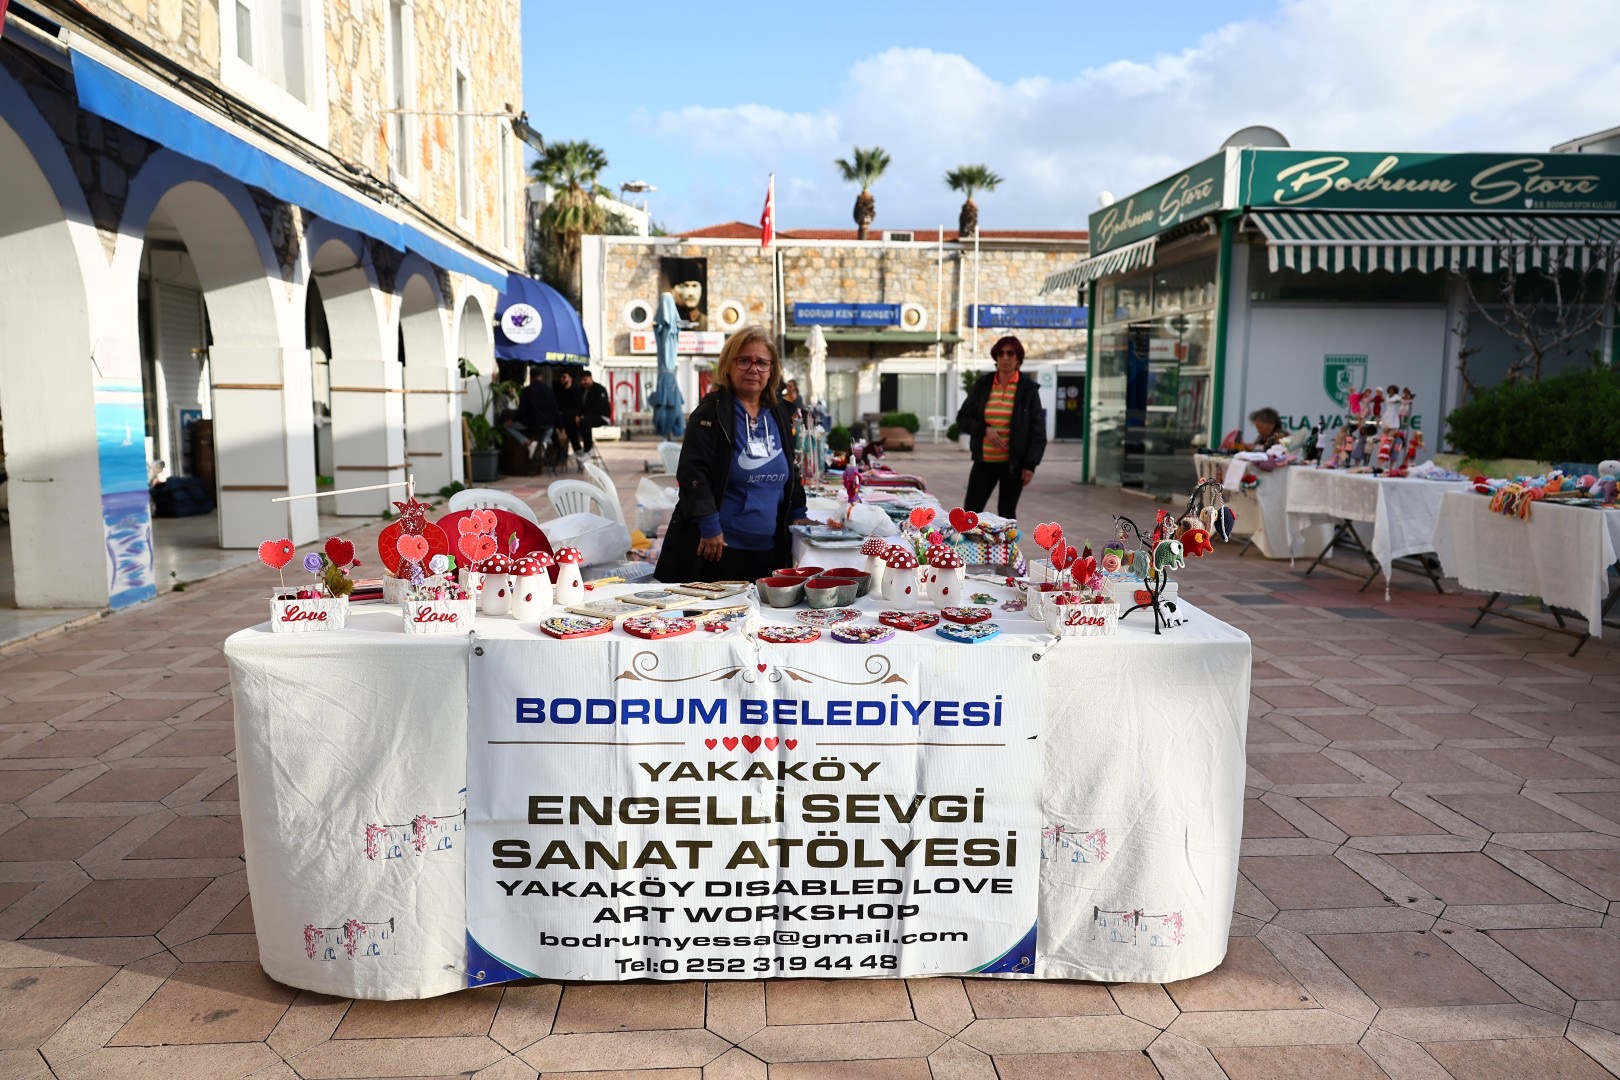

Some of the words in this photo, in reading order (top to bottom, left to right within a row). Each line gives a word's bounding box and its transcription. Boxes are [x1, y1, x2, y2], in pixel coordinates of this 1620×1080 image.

[1273, 155, 1458, 205] Bodrum
[1469, 158, 1600, 205] Store
[1097, 198, 1155, 251] Bodrum
[1158, 174, 1214, 226] Store
[1547, 201, 1573, 209] BODRUM
[1574, 201, 1591, 209] SPOR
[797, 308, 834, 318] BODRUM
[835, 309, 858, 318] KENT
[747, 475, 765, 483] JUST
[766, 474, 778, 482] DO
[778, 473, 786, 482] IT
[281, 604, 327, 622] Love
[413, 605, 458, 623] Love
[1064, 609, 1105, 626] Love
[516, 697, 729, 725] BODRUM
[739, 693, 1003, 727] BELEDİYESİ
[638, 756, 882, 782] YAKAKÖY
[527, 785, 785, 826] ENGELLİ
[801, 787, 985, 824] SEVGİ
[492, 839, 713, 871] SANAT
[724, 830, 1018, 870] ATÖLYESİ
[495, 876, 696, 898] YAKAKÖY
[705, 878, 904, 898] DISABLED
[912, 877, 1014, 895] LOVE
[592, 905, 676, 924] ART
[683, 902, 920, 923] WORKSHOP
[539, 929, 968, 949] bodrumyessa@gmail.com
[614, 957, 679, 974] Tel:0
[686, 958, 745, 973] 252
[752, 956, 807, 972] 319
[814, 955, 853, 971] 44
[859, 954, 898, 970] 48
